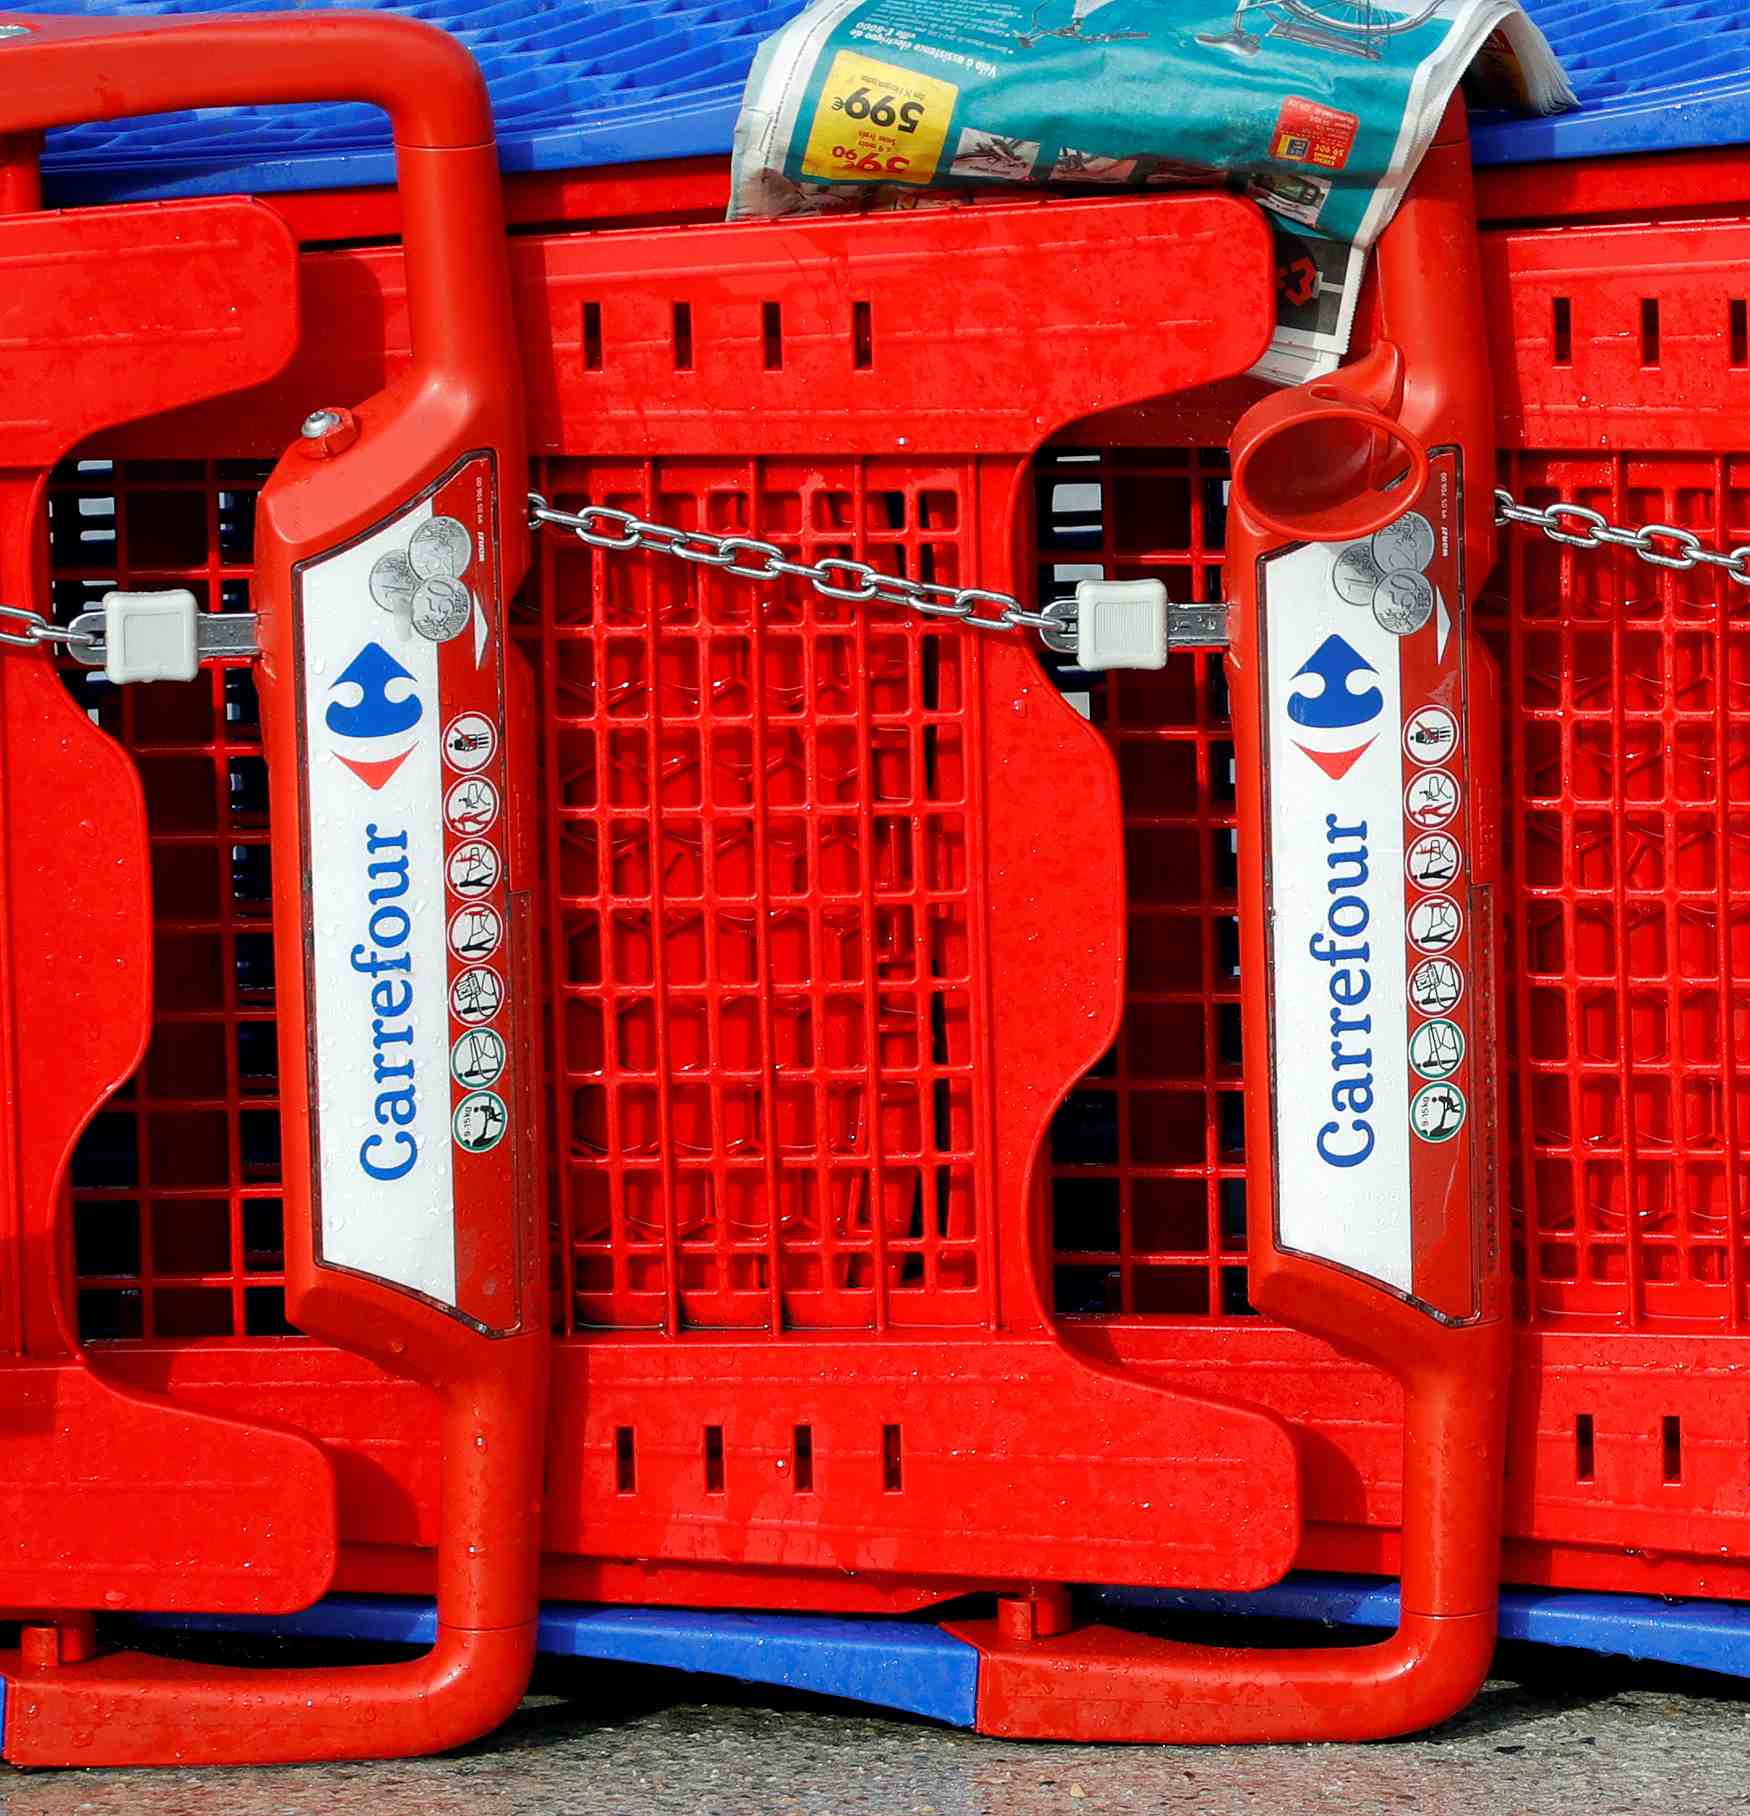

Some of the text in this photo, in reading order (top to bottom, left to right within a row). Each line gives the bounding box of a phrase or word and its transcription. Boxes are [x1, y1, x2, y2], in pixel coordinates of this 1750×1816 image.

[831, 86, 924, 135] 599€
[477, 531, 485, 562] wanzl
[1440, 526, 1449, 557] wanzl
[426, 579, 453, 613] 50
[1391, 577, 1418, 610] 50
[350, 824, 419, 1182] Carrefour
[1309, 814, 1375, 1169] Carrefour
